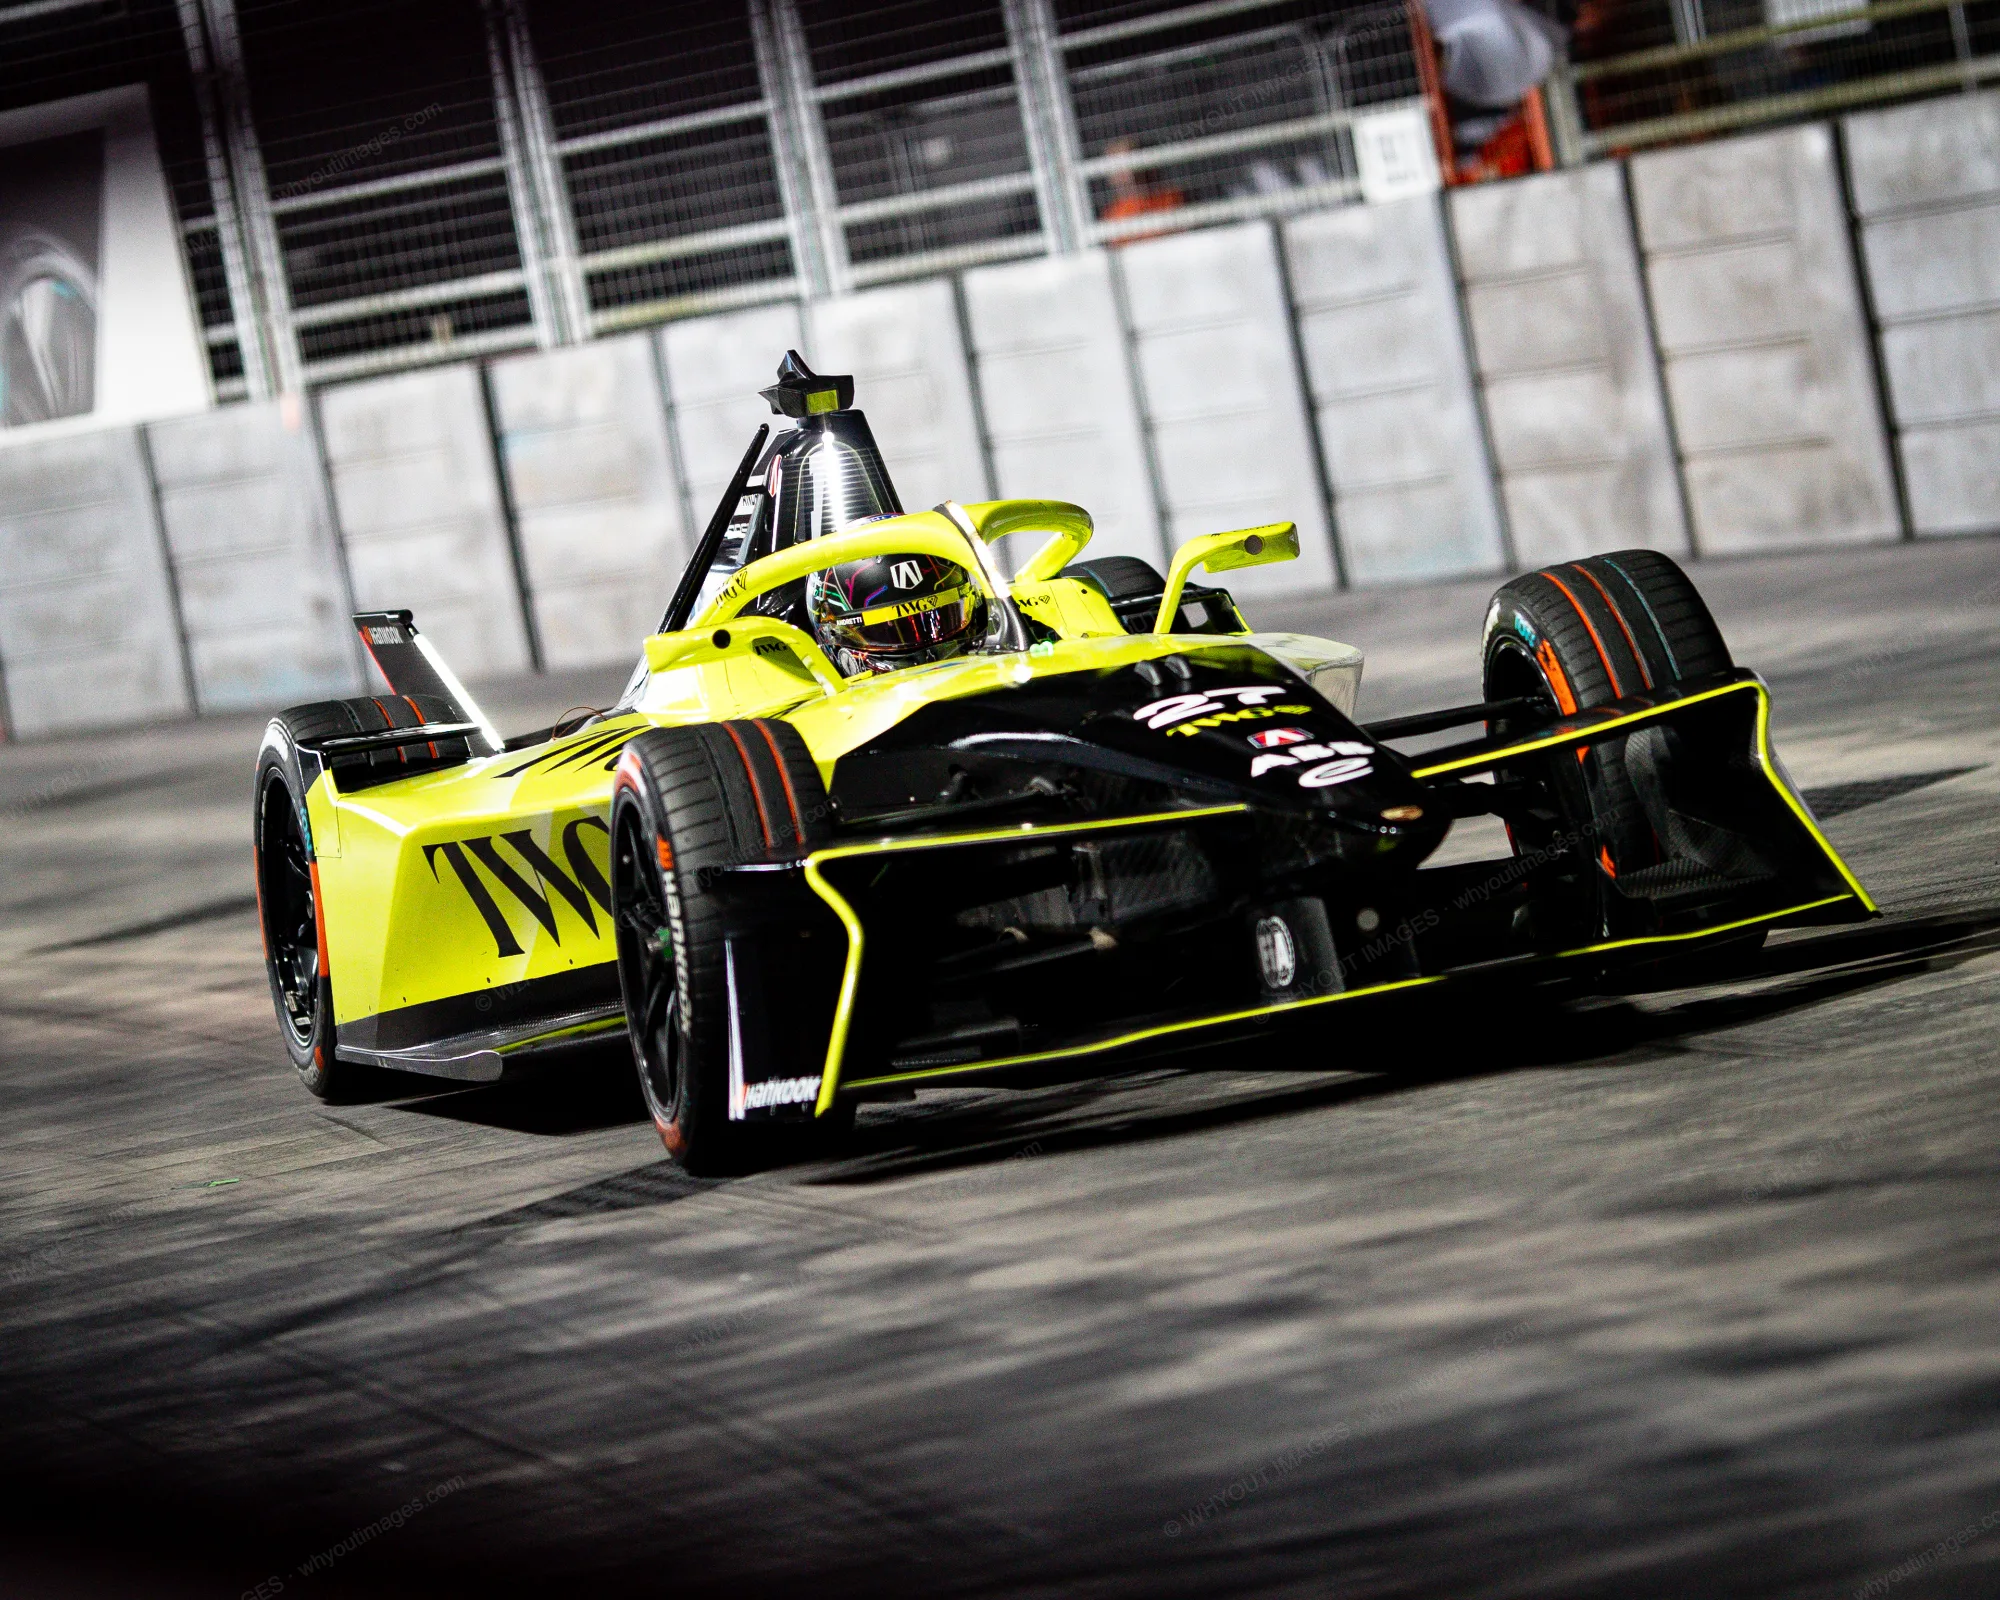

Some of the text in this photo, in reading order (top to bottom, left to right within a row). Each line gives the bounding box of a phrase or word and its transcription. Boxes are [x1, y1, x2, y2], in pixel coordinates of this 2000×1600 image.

[892, 599, 928, 619] TWG
[1132, 685, 1287, 730] 27
[1250, 740, 1376, 778] ABB
